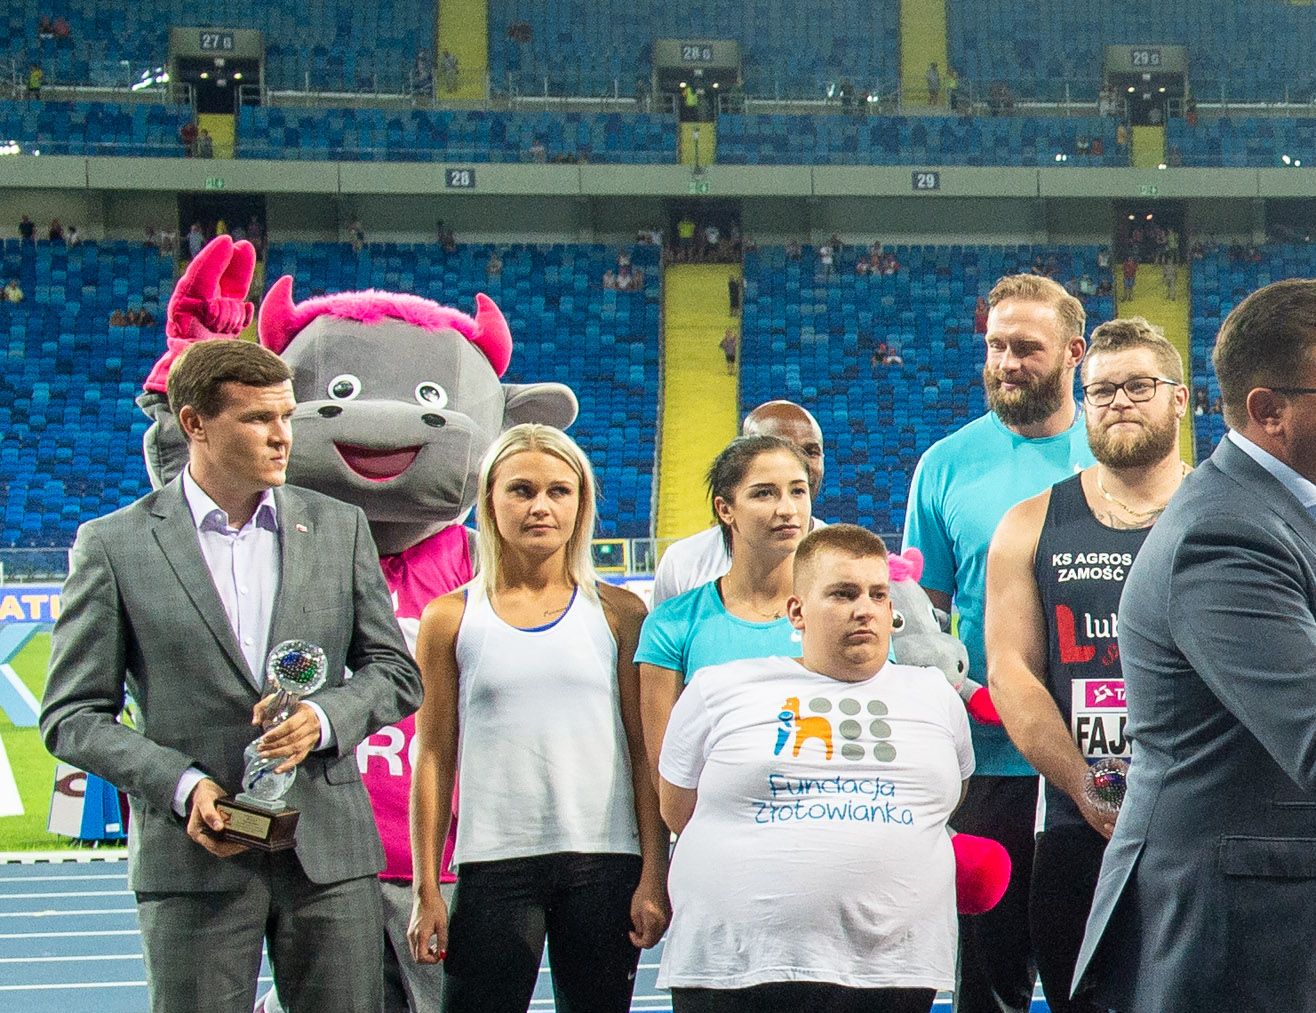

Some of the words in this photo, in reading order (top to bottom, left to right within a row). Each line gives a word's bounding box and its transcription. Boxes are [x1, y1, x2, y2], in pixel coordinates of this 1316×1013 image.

[202, 34, 219, 49] 27
[683, 45, 699, 60] 28
[1133, 50, 1148, 65] 29
[450, 170, 469, 185] 28
[917, 173, 935, 188] 29
[1052, 553, 1072, 567] KS
[1075, 553, 1132, 566] AGROS
[1057, 566, 1124, 582] ZAMOŚĆ
[1077, 716, 1132, 755] FAJ
[769, 774, 895, 801] Fundacja
[752, 799, 913, 825] Złotowianka
